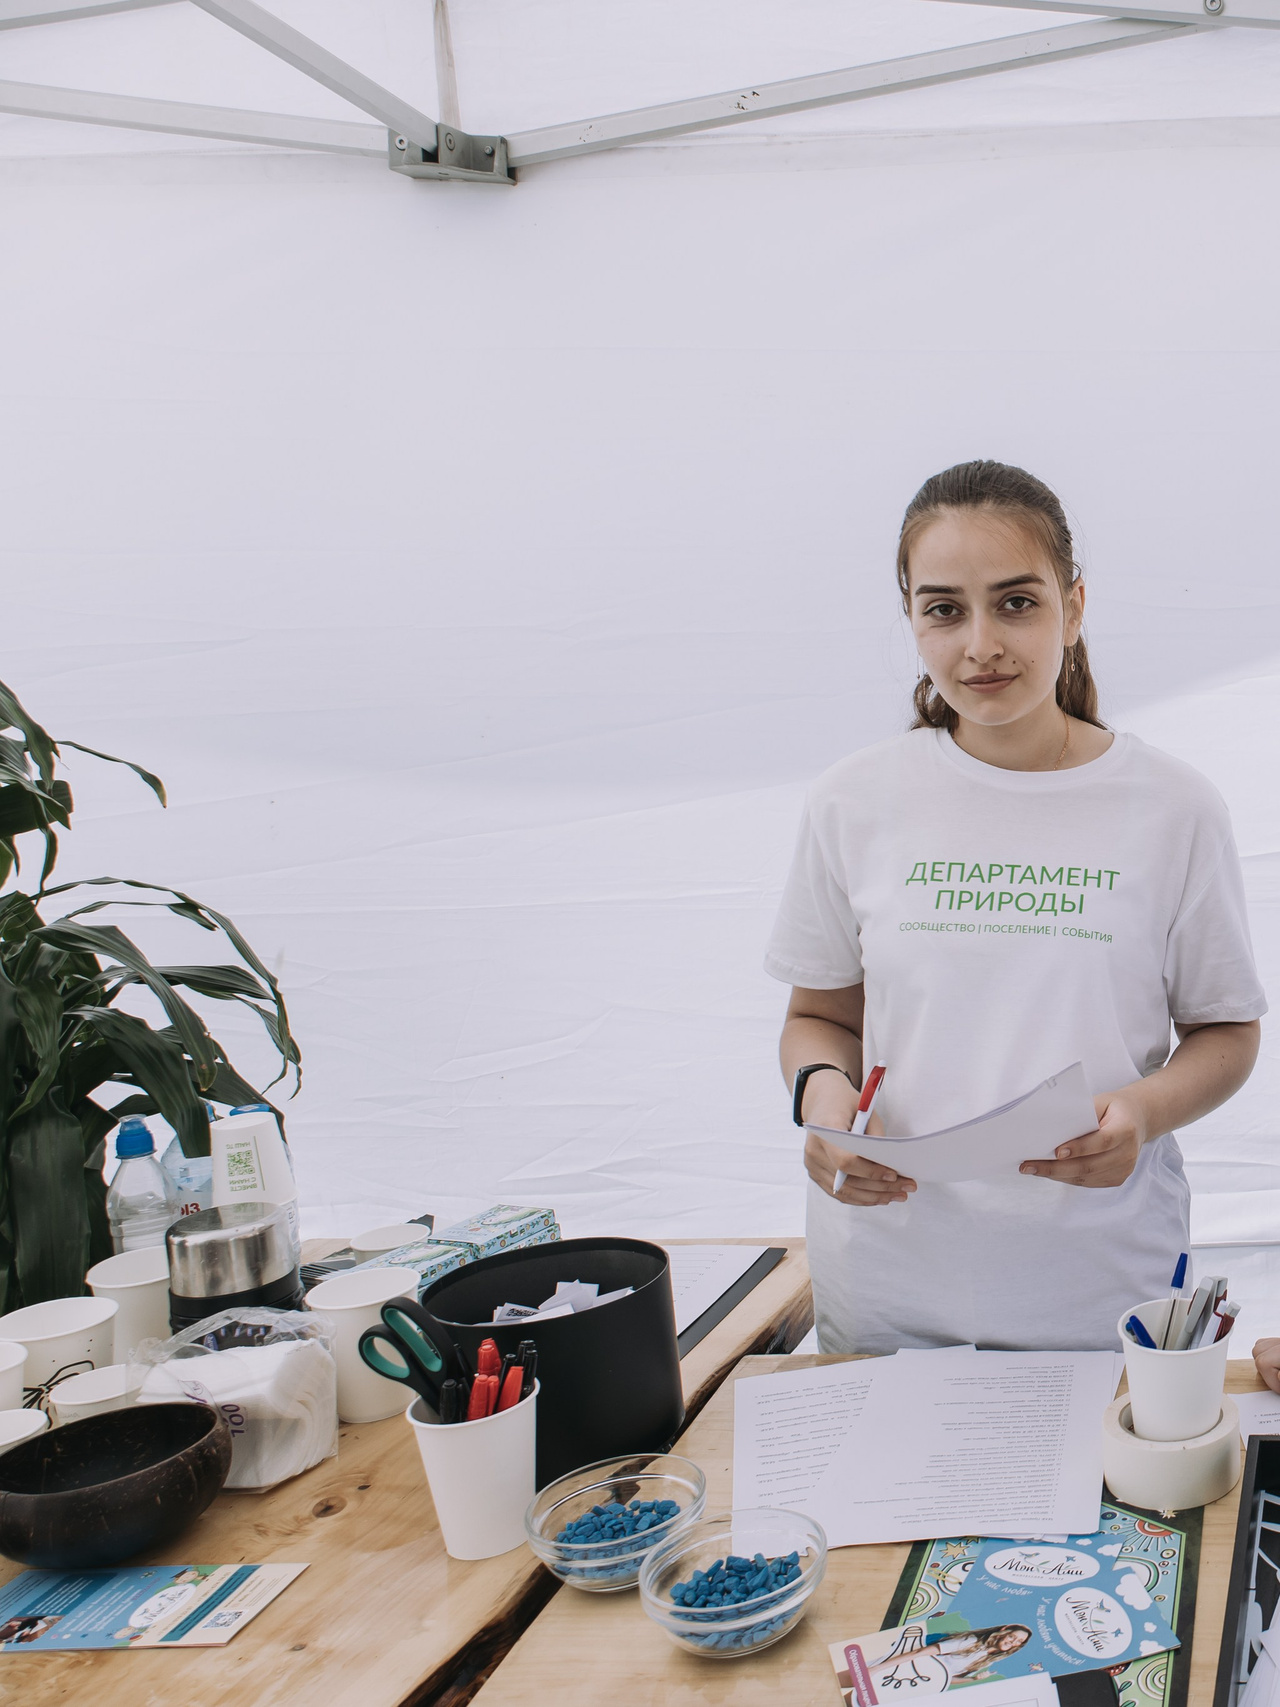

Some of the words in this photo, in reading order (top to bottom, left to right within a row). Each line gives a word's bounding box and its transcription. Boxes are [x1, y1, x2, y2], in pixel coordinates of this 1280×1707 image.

[905, 861, 1121, 891] ДЕПАРТАМЕНТ
[935, 889, 1085, 917] ПРИРОДЫ
[899, 921, 976, 933] СООБЩЕСТВО
[983, 924, 1052, 935] ПОСЕЛЕНИЕ
[1061, 926, 1113, 944] СОБЫТИЯ
[228, 1177, 250, 1185] НАМИ
[229, 1182, 258, 1192] ВМЕСТЕ
